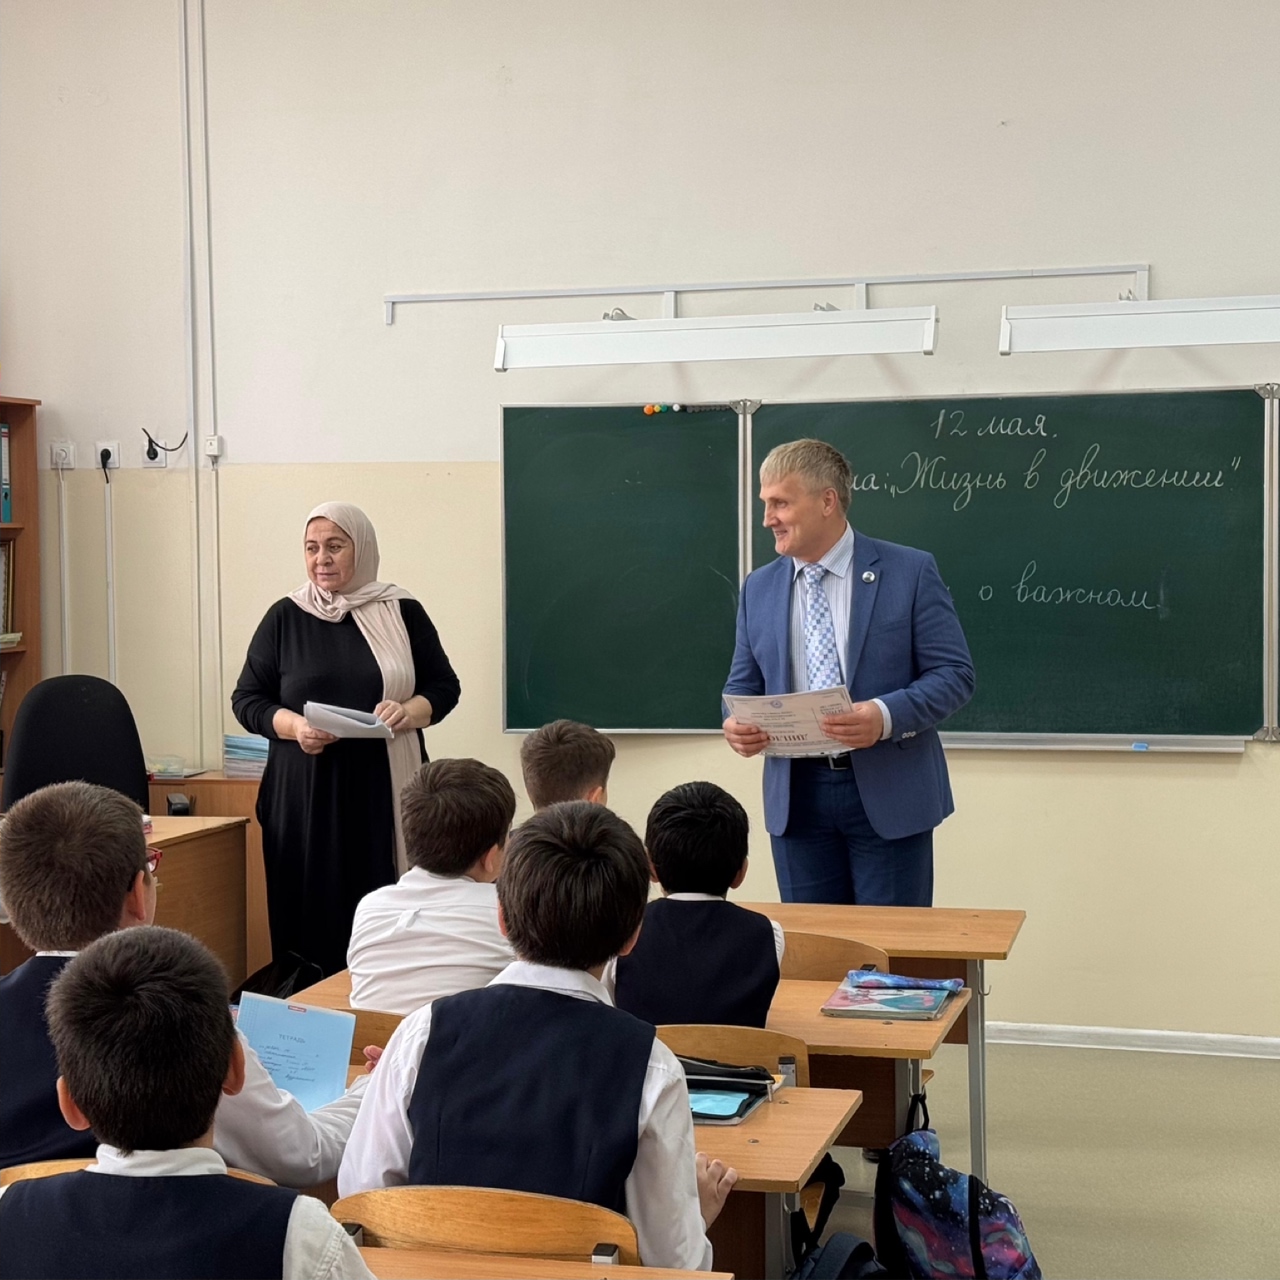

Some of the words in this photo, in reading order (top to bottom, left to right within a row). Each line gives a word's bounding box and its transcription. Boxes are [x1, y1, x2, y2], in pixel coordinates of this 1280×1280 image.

[930, 409, 967, 439] 12
[978, 414, 1058, 438] мая.
[1024, 448, 1047, 489] в
[978, 584, 993, 601] о
